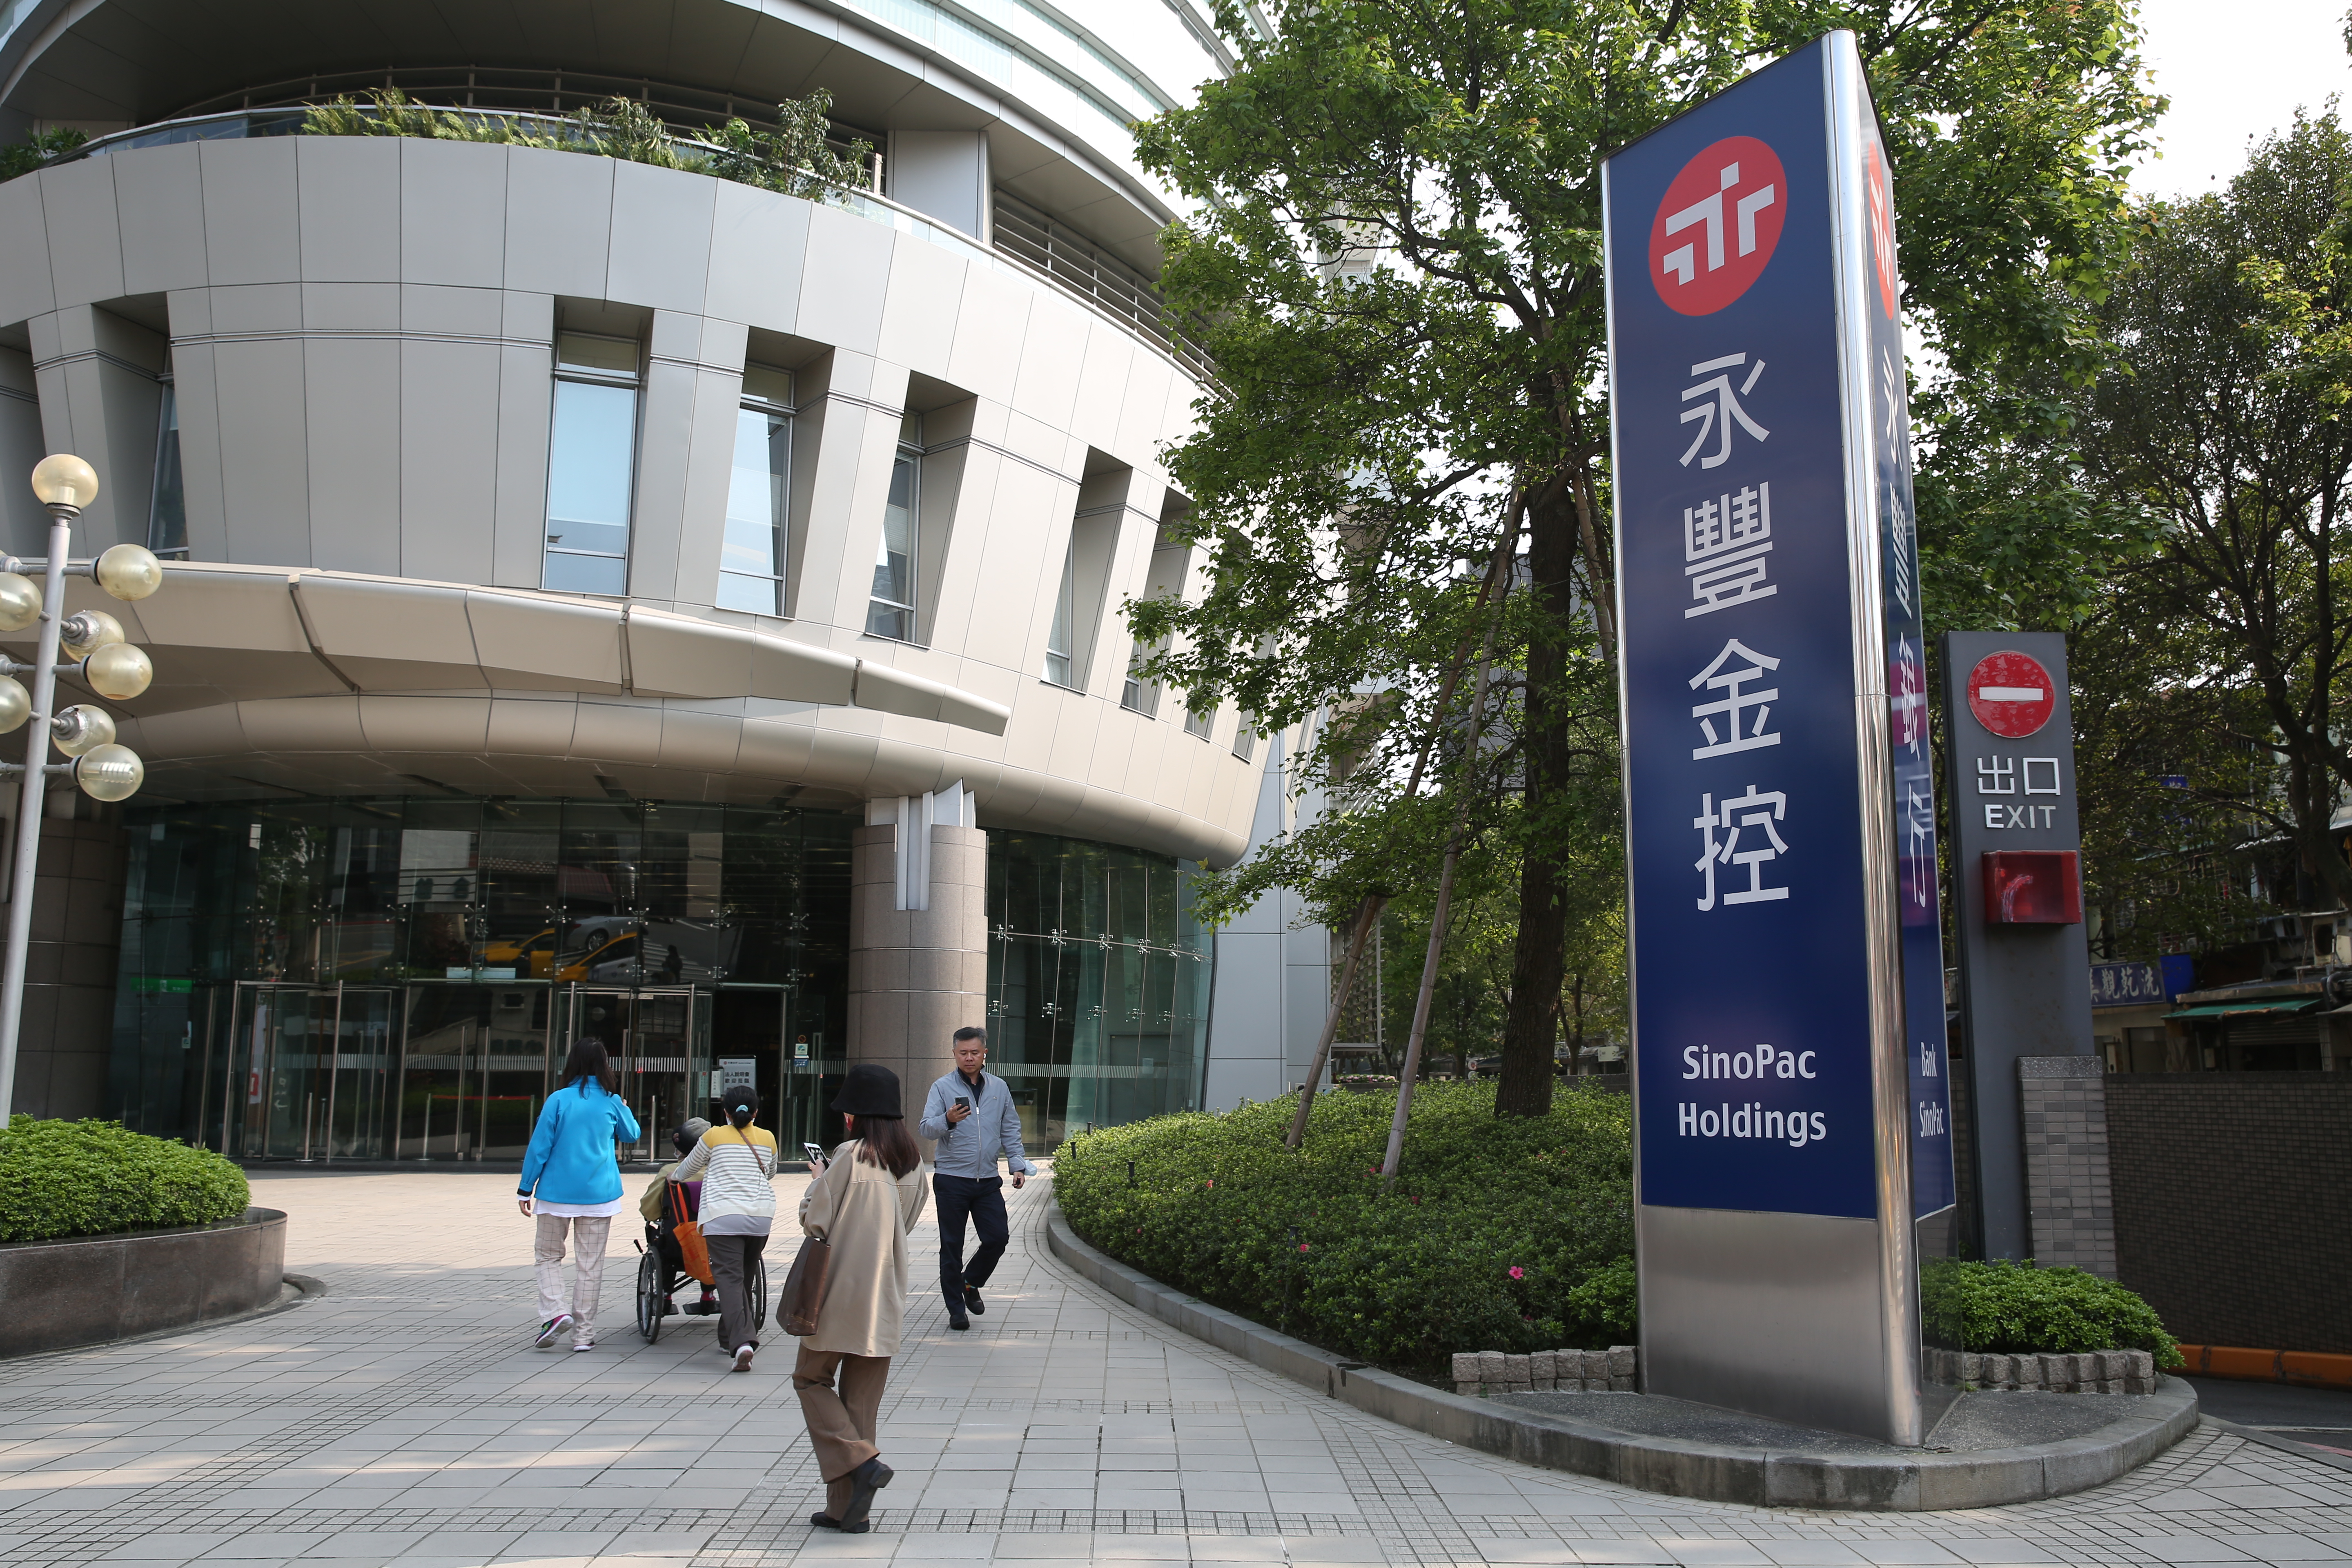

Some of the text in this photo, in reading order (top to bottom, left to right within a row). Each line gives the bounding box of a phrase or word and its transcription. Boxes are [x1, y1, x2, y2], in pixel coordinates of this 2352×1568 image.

[1679, 352, 1789, 911] 永豐金控
[1883, 345, 1926, 907] 永豐銀行
[1977, 755, 2061, 795] 出口
[1985, 804, 2056, 829] EXIT
[1682, 1044, 1816, 1079] SinoPac
[1920, 1042, 1937, 1077] Bank
[1679, 1102, 1826, 1147] Holdings
[1920, 1101, 1944, 1137] SinoPac
